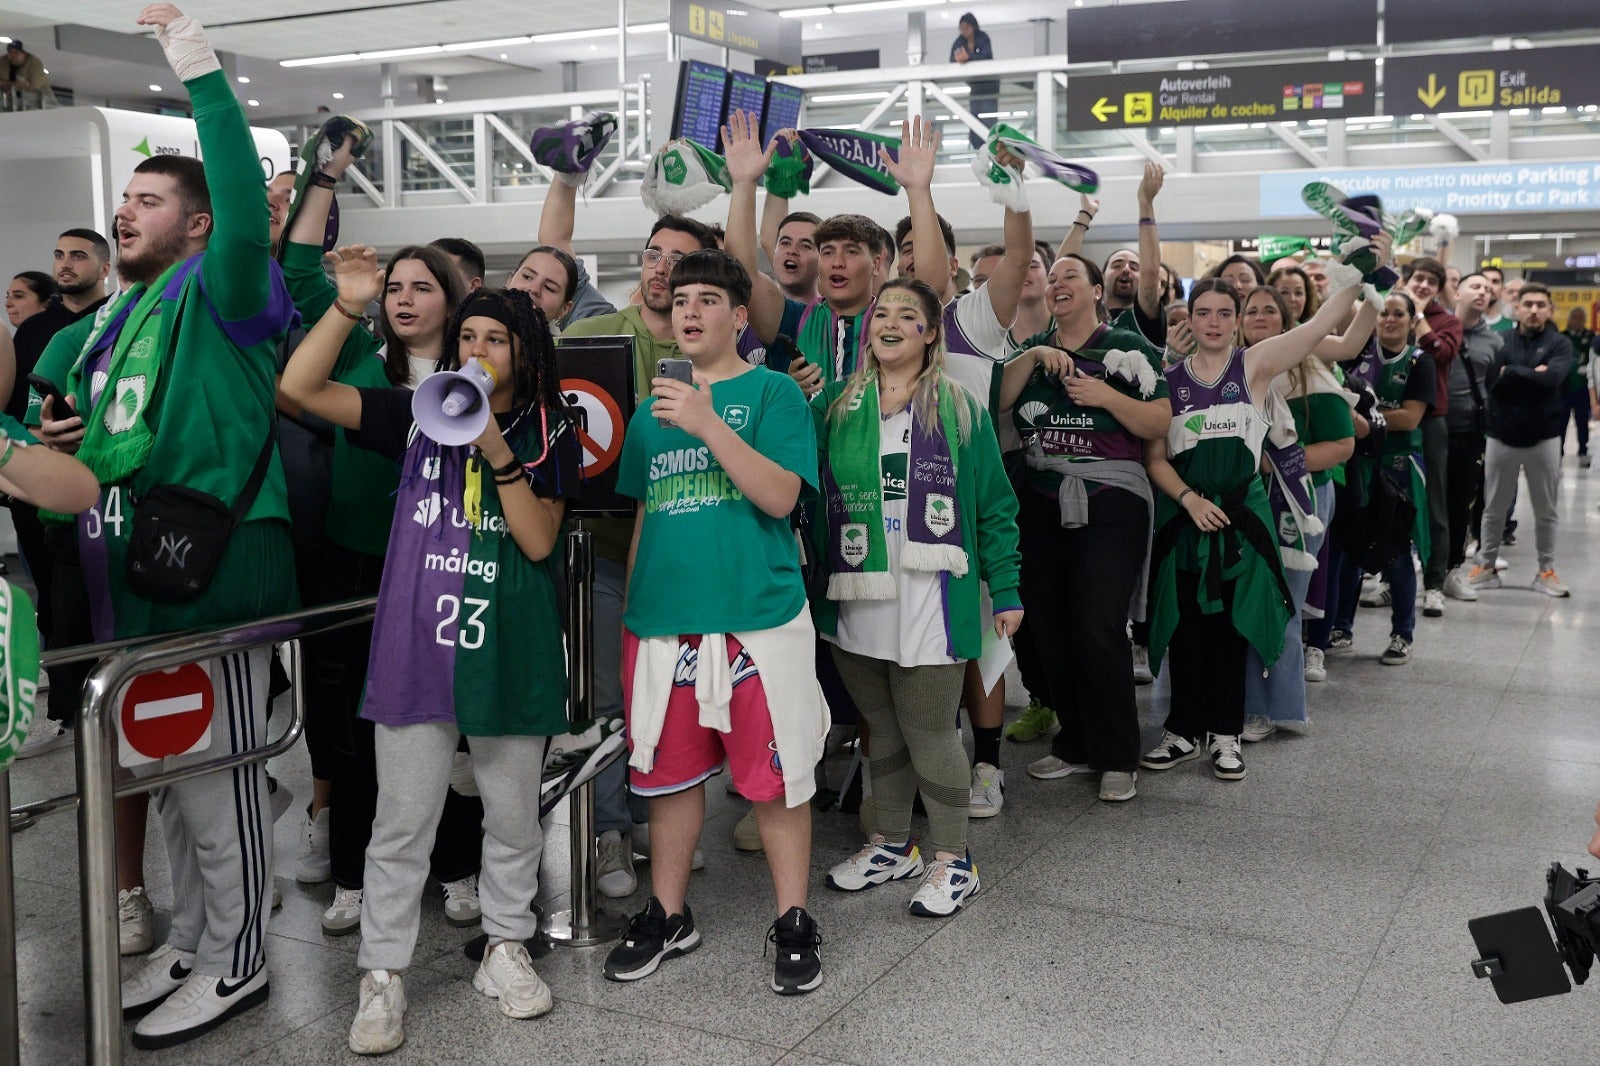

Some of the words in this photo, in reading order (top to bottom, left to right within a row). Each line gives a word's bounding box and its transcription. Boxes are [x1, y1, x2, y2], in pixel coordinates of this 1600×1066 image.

[1159, 75, 1232, 92] Autoverleih
[1500, 70, 1526, 87] Exit
[1159, 93, 1178, 106] Car
[1181, 92, 1216, 105] Rental
[1500, 85, 1561, 106] Salida
[1159, 104, 1208, 122] Alquiler
[1211, 104, 1228, 118] de
[1230, 102, 1276, 117] coches
[154, 145, 181, 156] aena
[1320, 174, 1391, 191] scubre
[1394, 172, 1457, 190] nuestro
[1459, 169, 1513, 187] nuevo
[1517, 166, 1589, 187] Parking
[1446, 191, 1511, 210] Priority
[1514, 190, 1543, 205] Car
[1548, 187, 1589, 205] Park
[1050, 413, 1094, 428] Unicaja
[436, 594, 490, 649] 23
